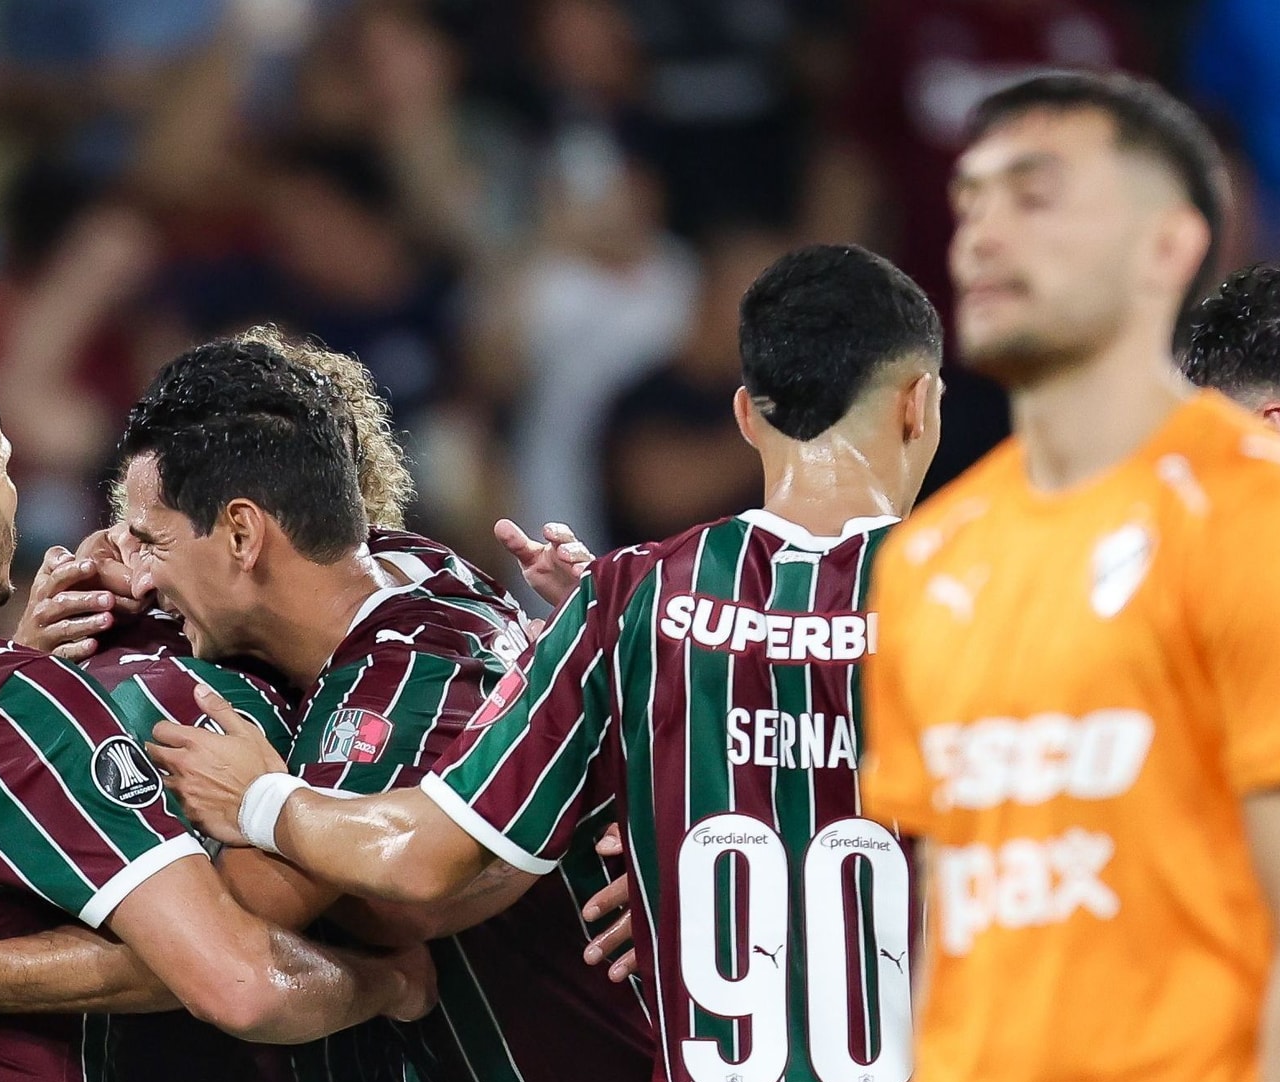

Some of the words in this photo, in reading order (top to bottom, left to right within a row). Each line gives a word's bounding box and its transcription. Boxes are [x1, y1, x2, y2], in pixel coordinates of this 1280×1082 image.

[727, 706, 858, 770] SERNA
[353, 740, 376, 755] 2023
[703, 831, 769, 846] predialnet
[830, 835, 891, 851] predialnet
